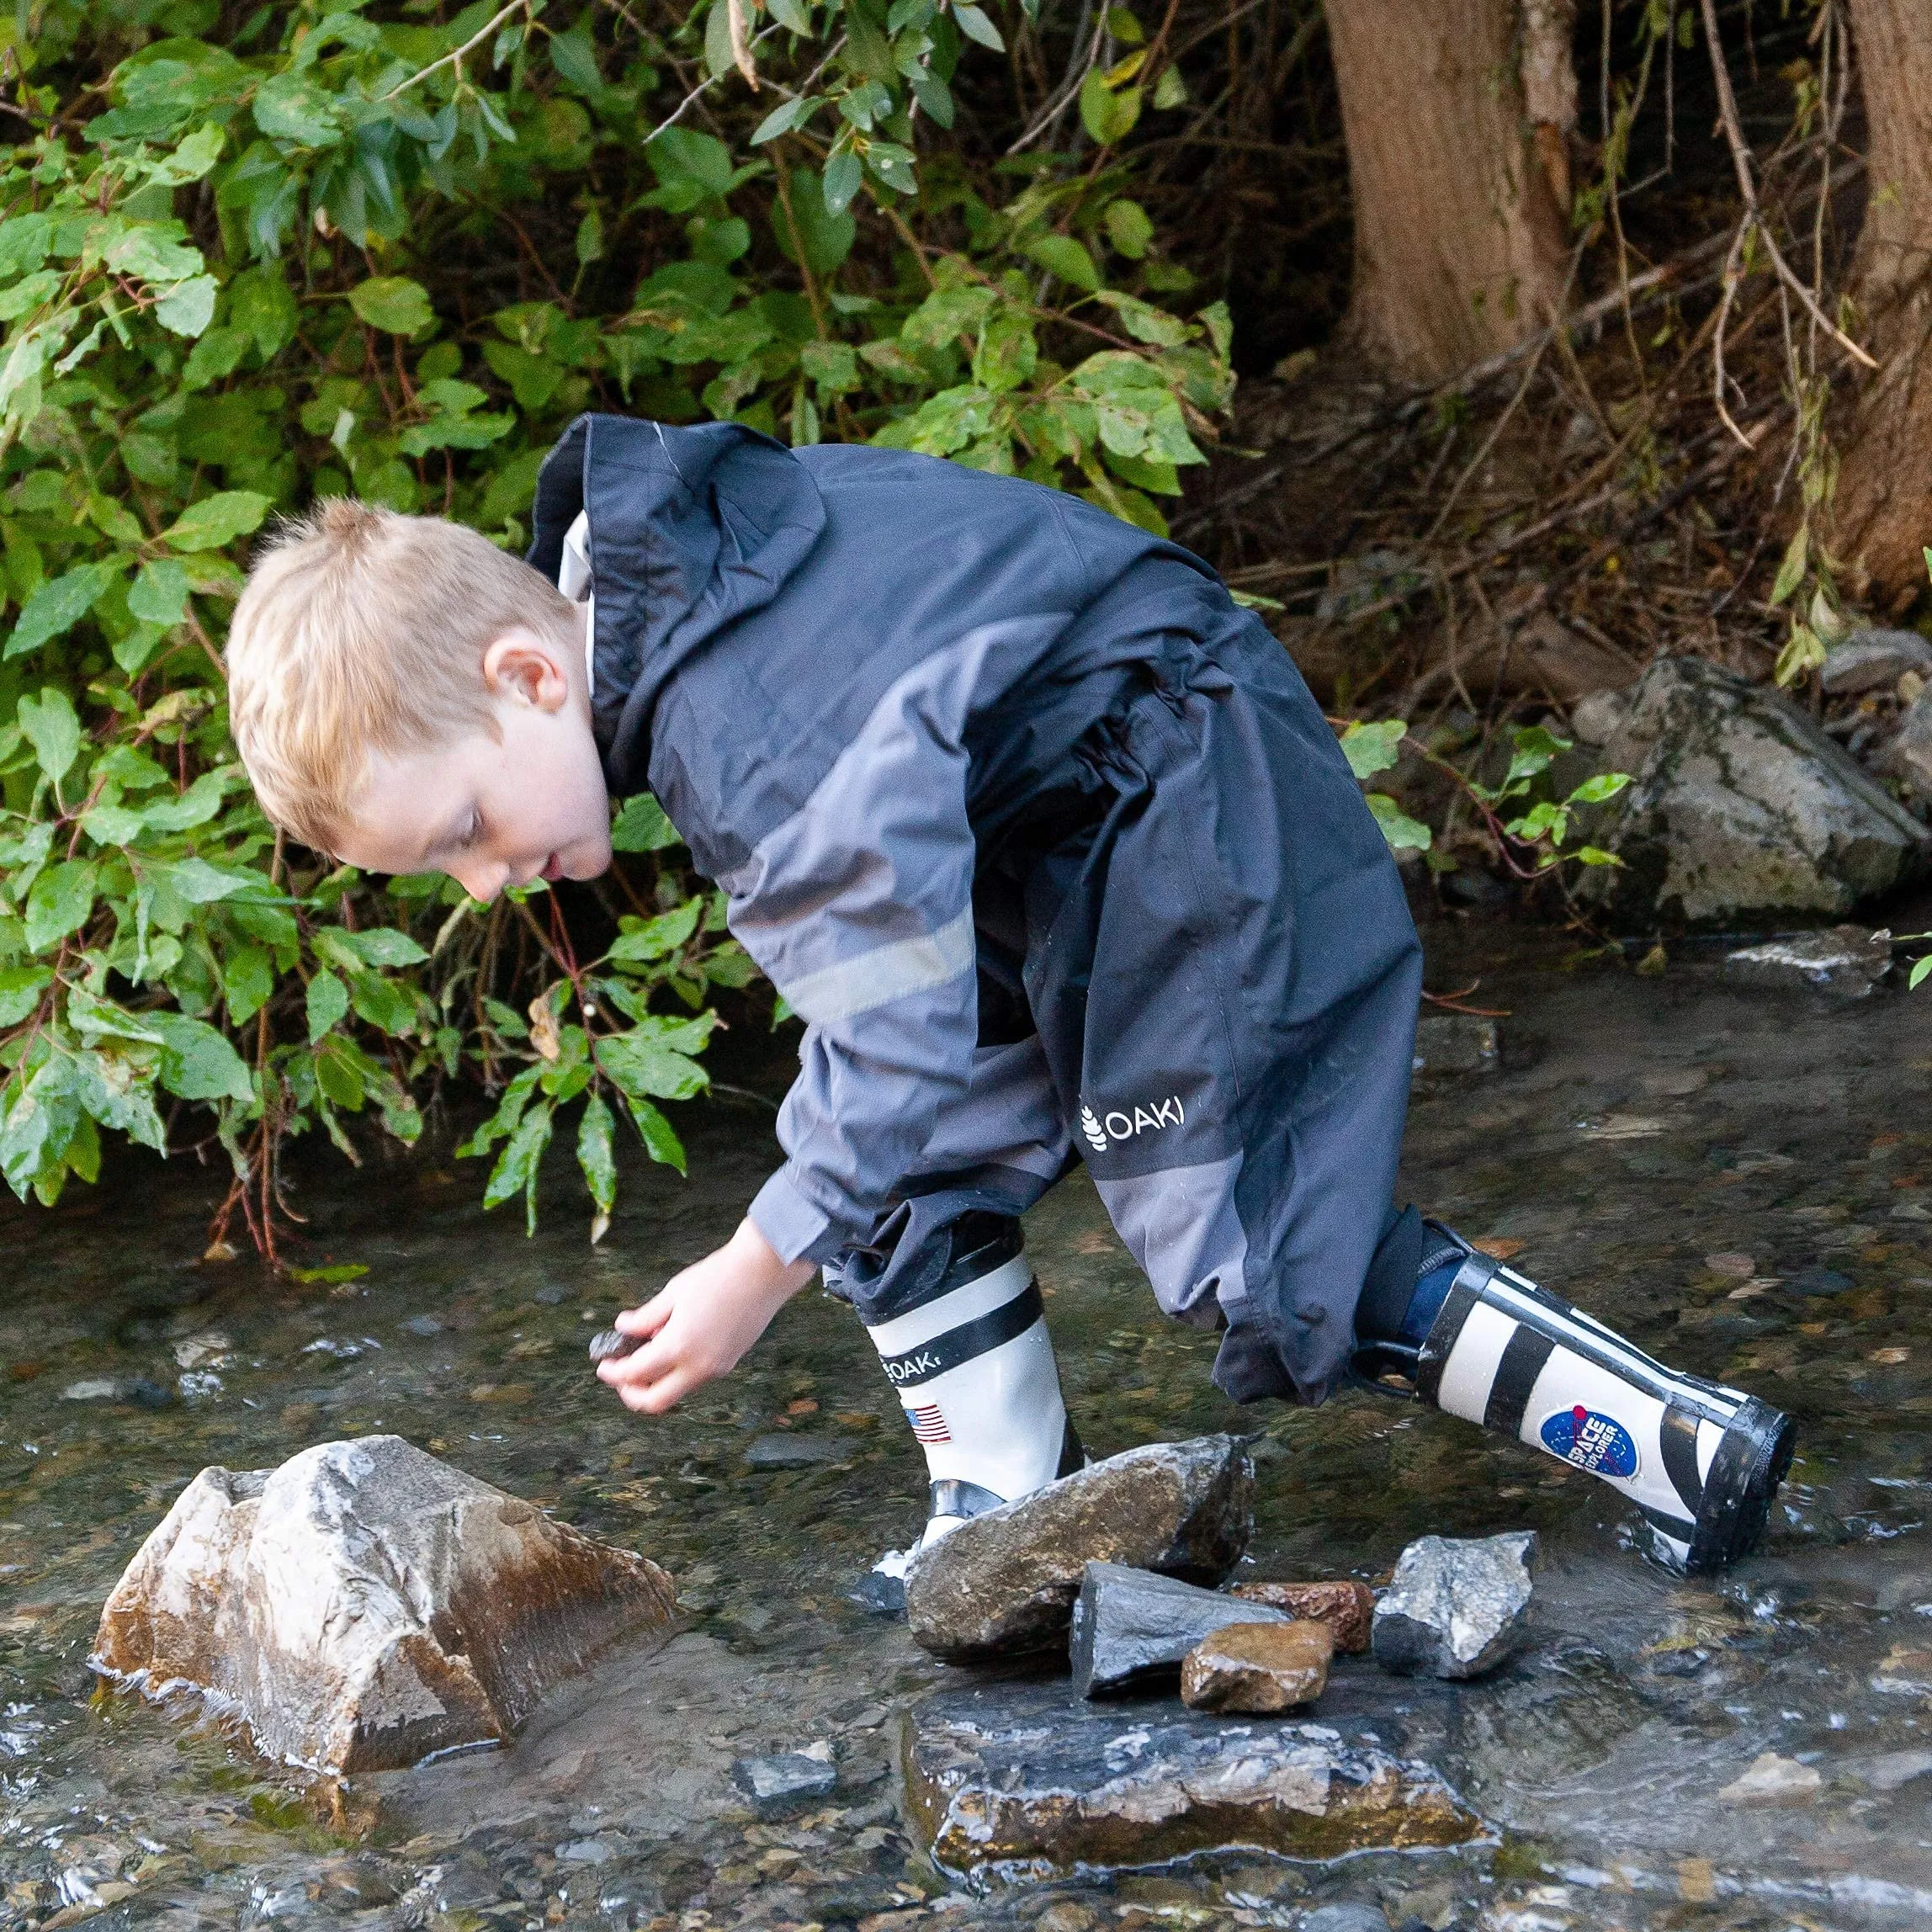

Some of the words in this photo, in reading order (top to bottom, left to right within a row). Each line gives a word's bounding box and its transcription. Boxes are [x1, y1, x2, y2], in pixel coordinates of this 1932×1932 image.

[1105, 1096, 1183, 1139] OAKI
[1568, 1417, 1606, 1463] SPACE
[1584, 1425, 1618, 1468] EXPLORER
